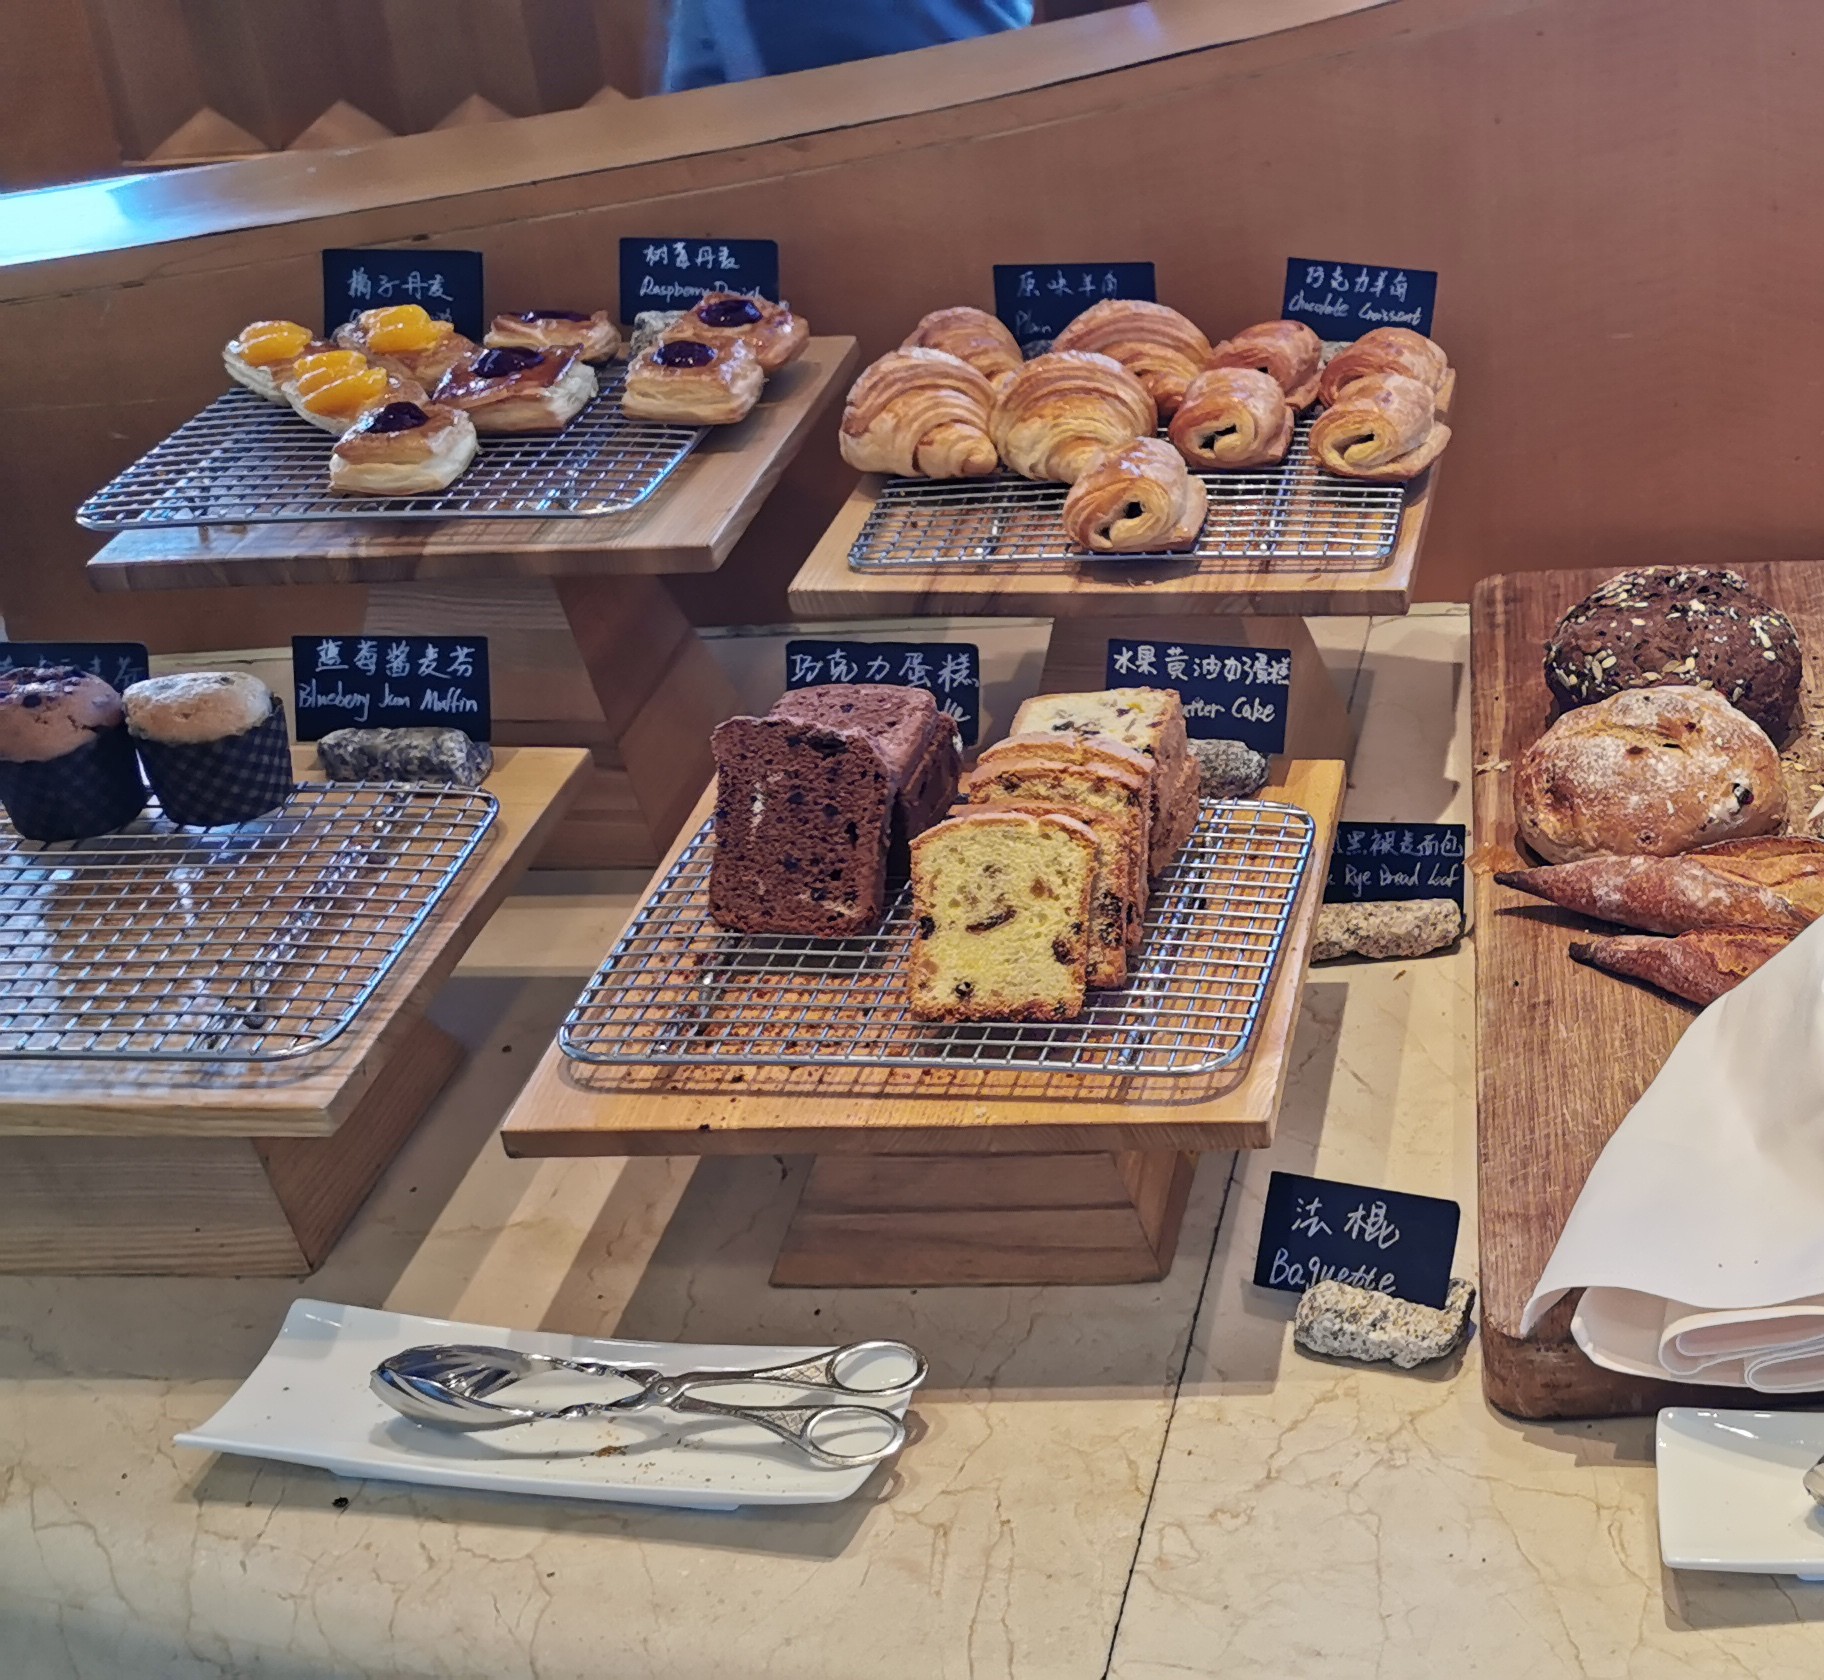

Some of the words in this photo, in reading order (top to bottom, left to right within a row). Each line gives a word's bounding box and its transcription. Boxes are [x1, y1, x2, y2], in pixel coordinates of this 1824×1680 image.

[790, 648, 980, 693] 巧克力蛋糕
[1231, 696, 1276, 723] Cake
[1345, 864, 1372, 897] Rye
[1291, 1196, 1400, 1250] 法棍
[1268, 1248, 1397, 1295] Baguette
